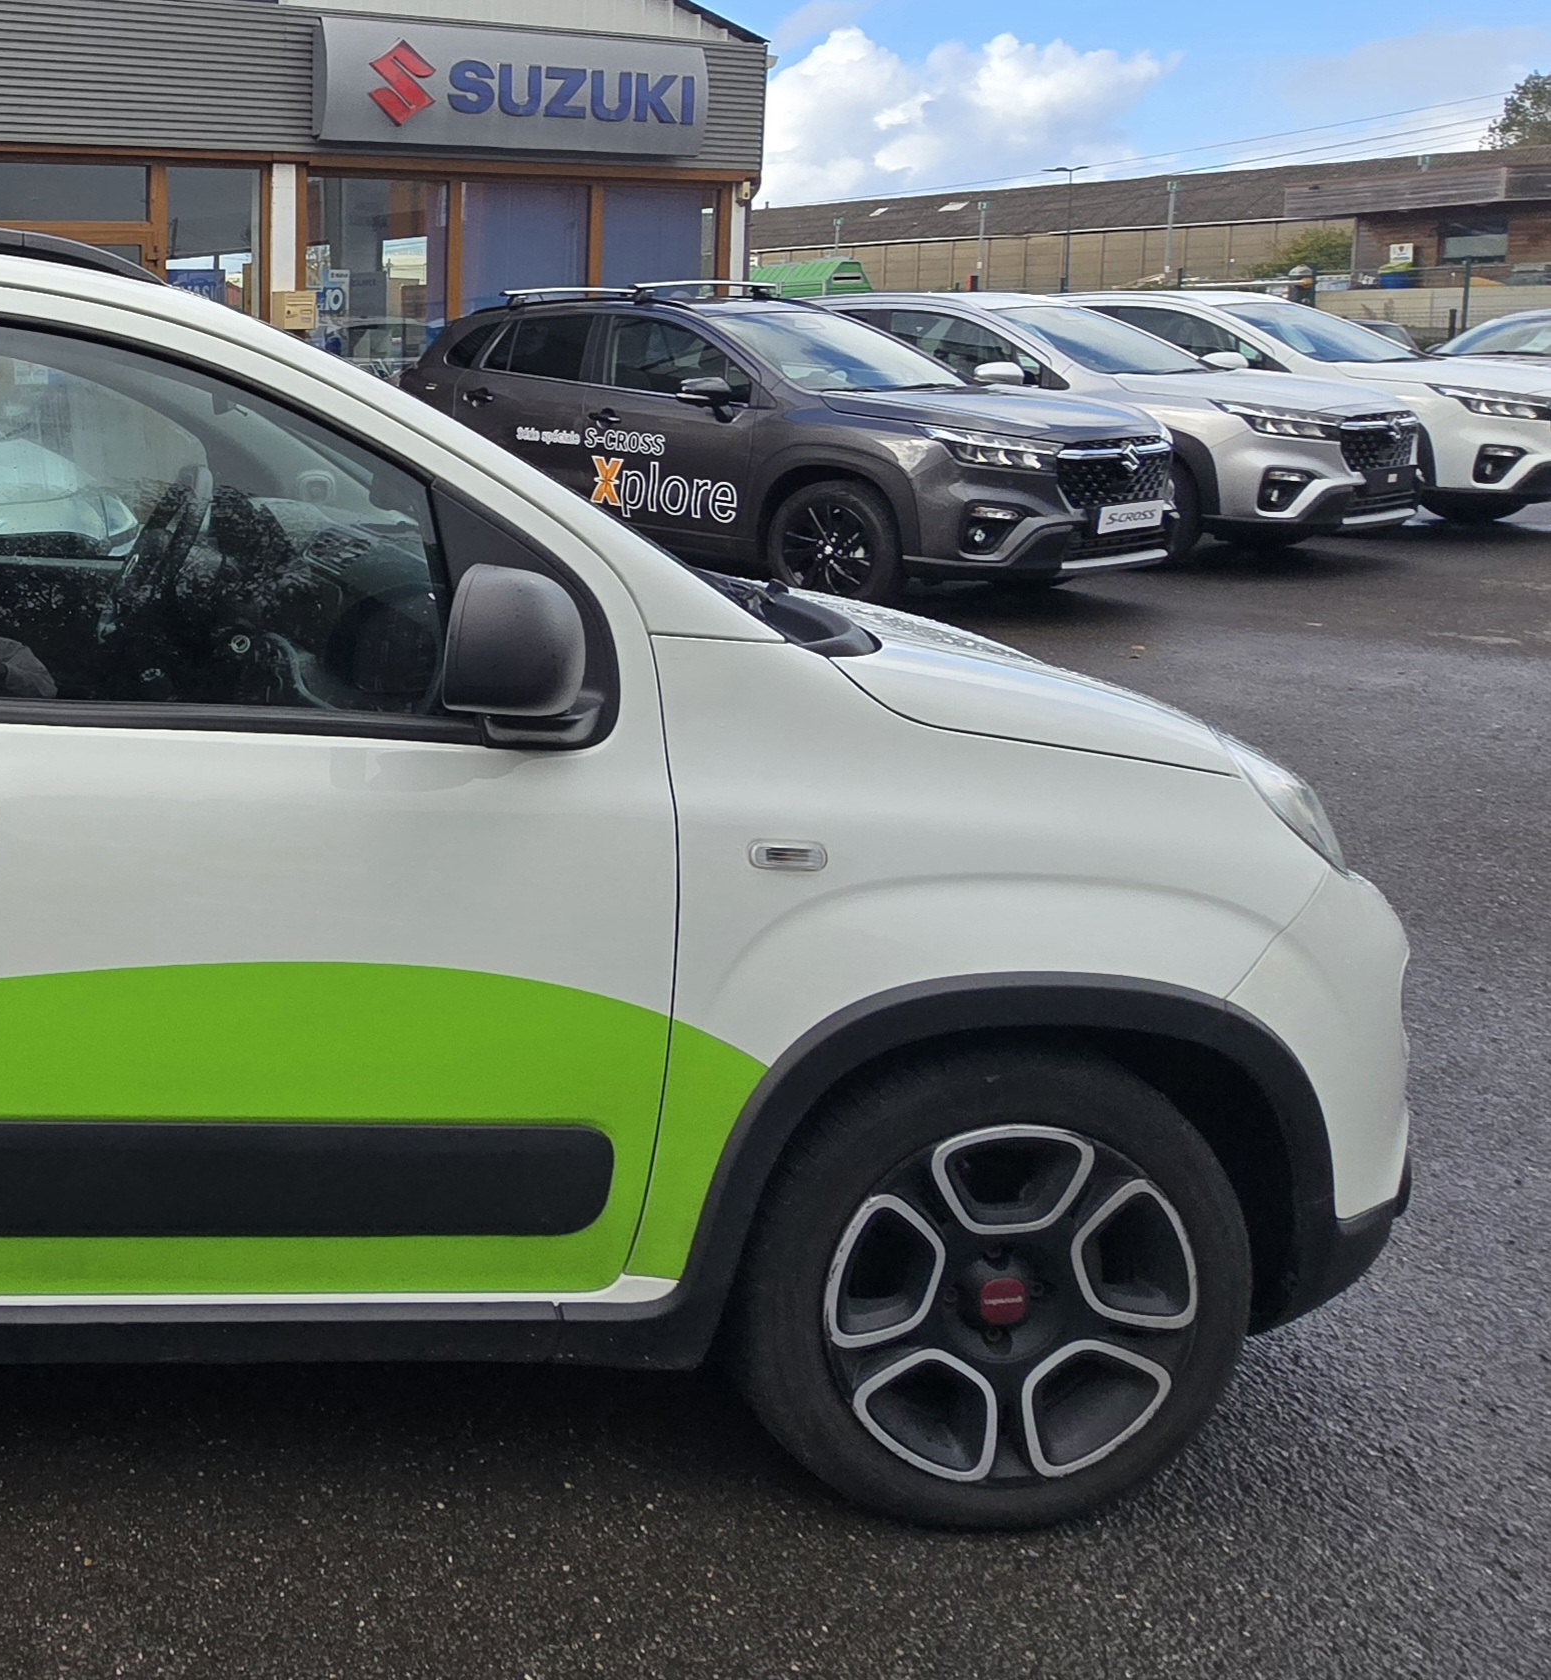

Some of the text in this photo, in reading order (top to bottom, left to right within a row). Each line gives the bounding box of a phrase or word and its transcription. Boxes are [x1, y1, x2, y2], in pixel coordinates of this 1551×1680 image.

[447, 59, 695, 126] SUZUKI
[584, 427, 666, 456] S-CROSS
[590, 455, 738, 524] Xplore
